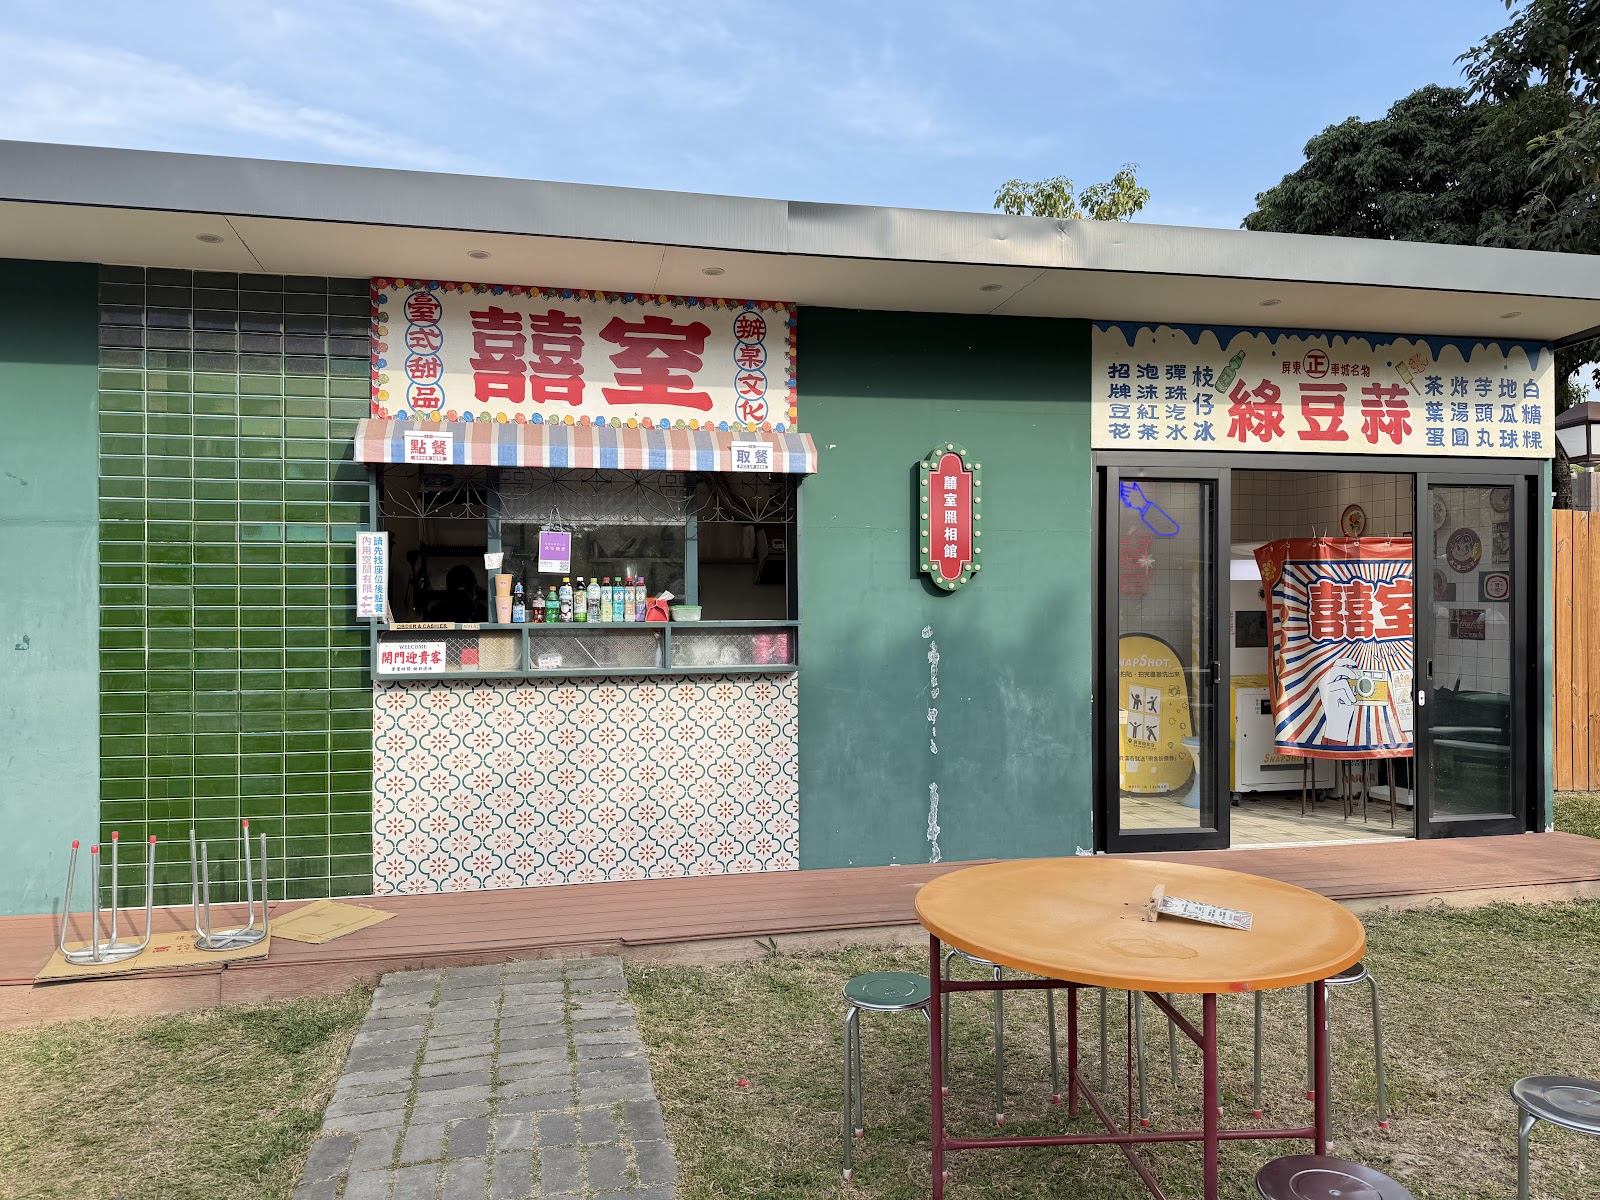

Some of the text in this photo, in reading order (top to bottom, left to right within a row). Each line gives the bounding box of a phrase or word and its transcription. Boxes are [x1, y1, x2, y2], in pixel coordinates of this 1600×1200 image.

[1107, 362, 1132, 440] 招牌豆花
[1136, 363, 1160, 440] 泡沫紅茶
[1164, 364, 1188, 441] 彈珠汽水
[1192, 365, 1216, 442] 枝仔冰
[1281, 361, 1302, 375] 屏東
[1331, 363, 1371, 378] 車城名物
[1227, 378, 1413, 445] 綠豆蒜
[1424, 375, 1446, 448] 茶葉蛋
[1450, 376, 1470, 447] 炸湯圓
[1474, 377, 1495, 448] 芋頭丸
[1498, 378, 1519, 449] 地瓜球
[1521, 378, 1543, 450] 白糖粿
[410, 439, 447, 456] 點餐
[736, 449, 768, 464] 取餐
[373, 536, 384, 613] 請先找座位後點餐
[381, 650, 442, 665] 開門迎貴客
